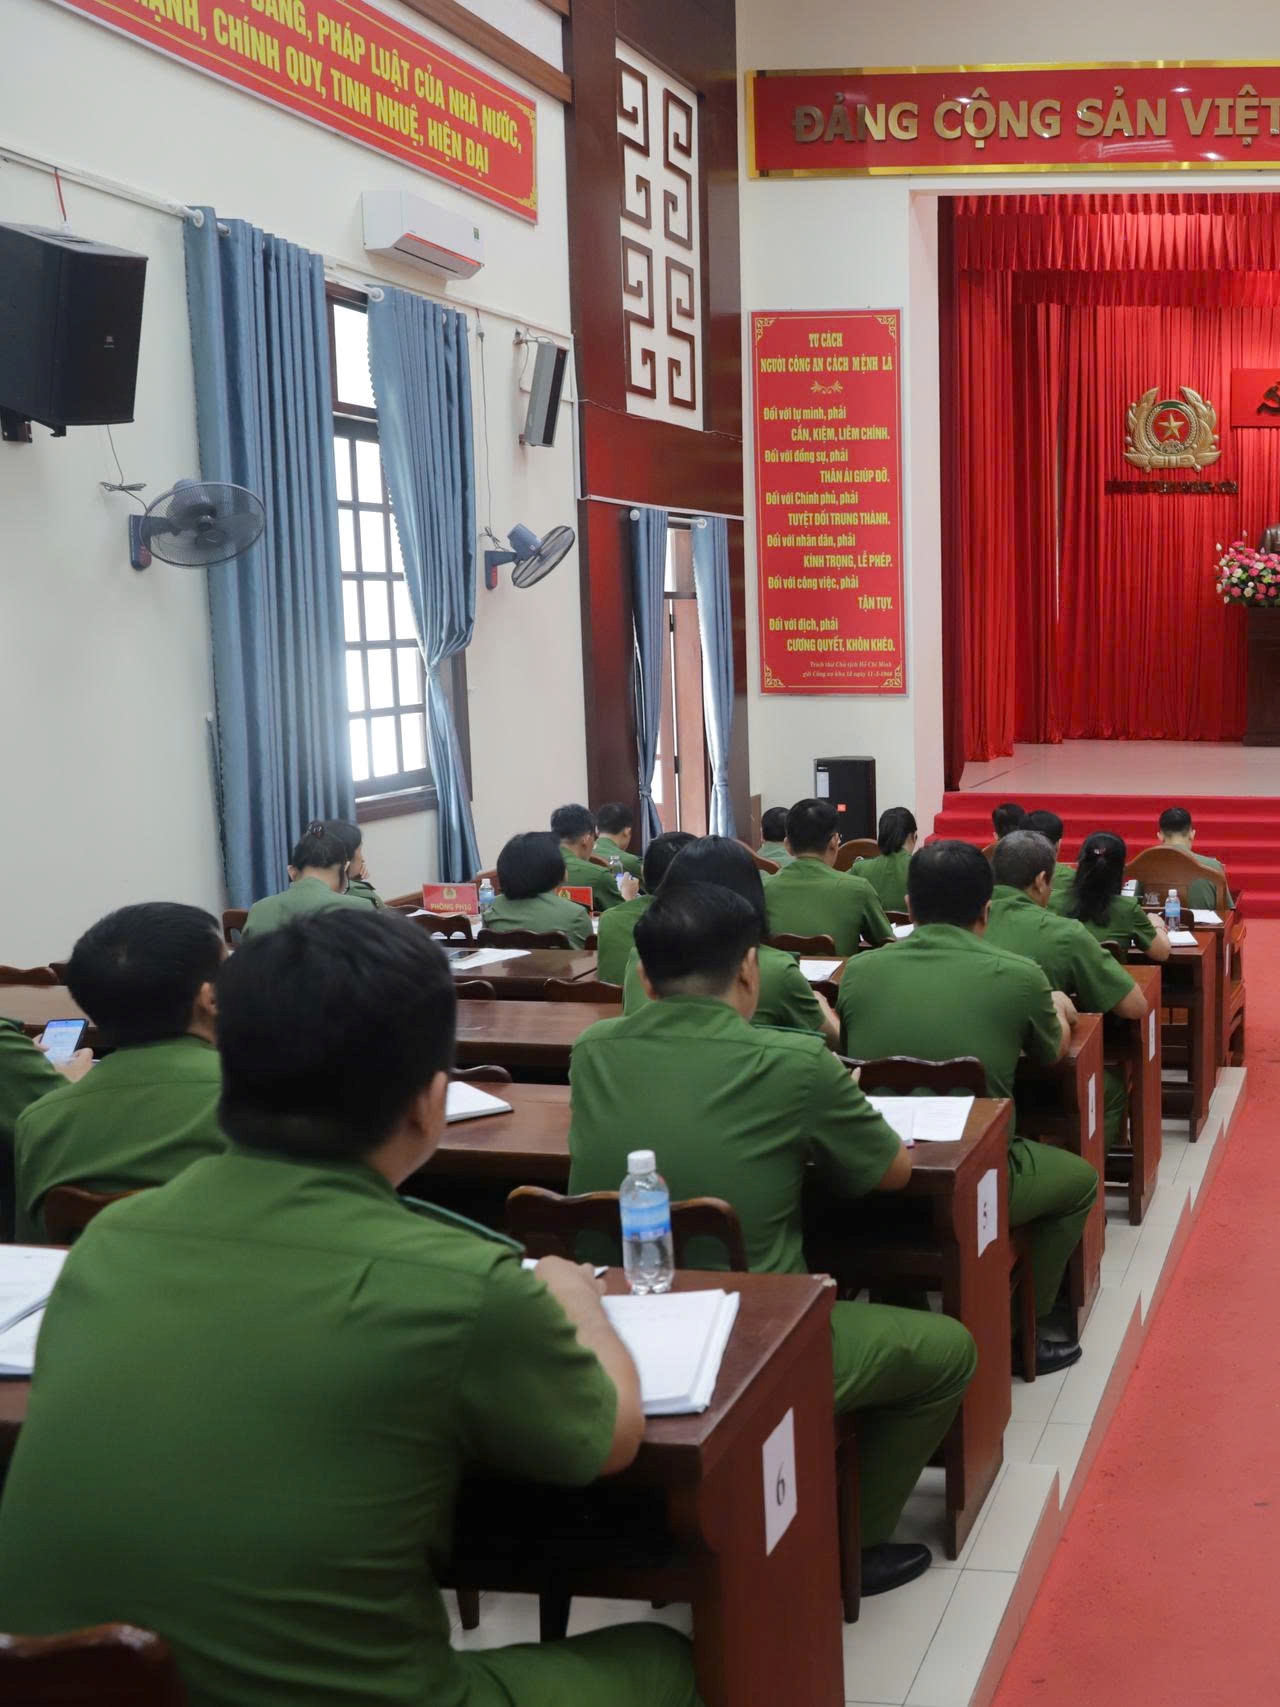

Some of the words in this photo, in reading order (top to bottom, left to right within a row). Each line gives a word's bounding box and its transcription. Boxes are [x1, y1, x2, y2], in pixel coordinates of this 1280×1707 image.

[213, 7, 280, 73] CHÍNH
[285, 45, 326, 99] QUY,
[330, 67, 371, 118] TINH
[376, 91, 424, 146] NHUỆ,
[428, 117, 462, 162] HIỆN
[466, 136, 489, 177] ĐẠI
[317, 12, 366, 65] PHÁP
[371, 42, 410, 92] LUẬT
[414, 64, 445, 110] CỦA
[449, 85, 478, 128] NHÀ
[482, 104, 522, 154] NƯỚC,
[792, 91, 920, 143] ĐẢNG
[934, 86, 1061, 148] CỘNG
[1076, 86, 1168, 139] SẢN
[776, 1461, 786, 1507] 6
